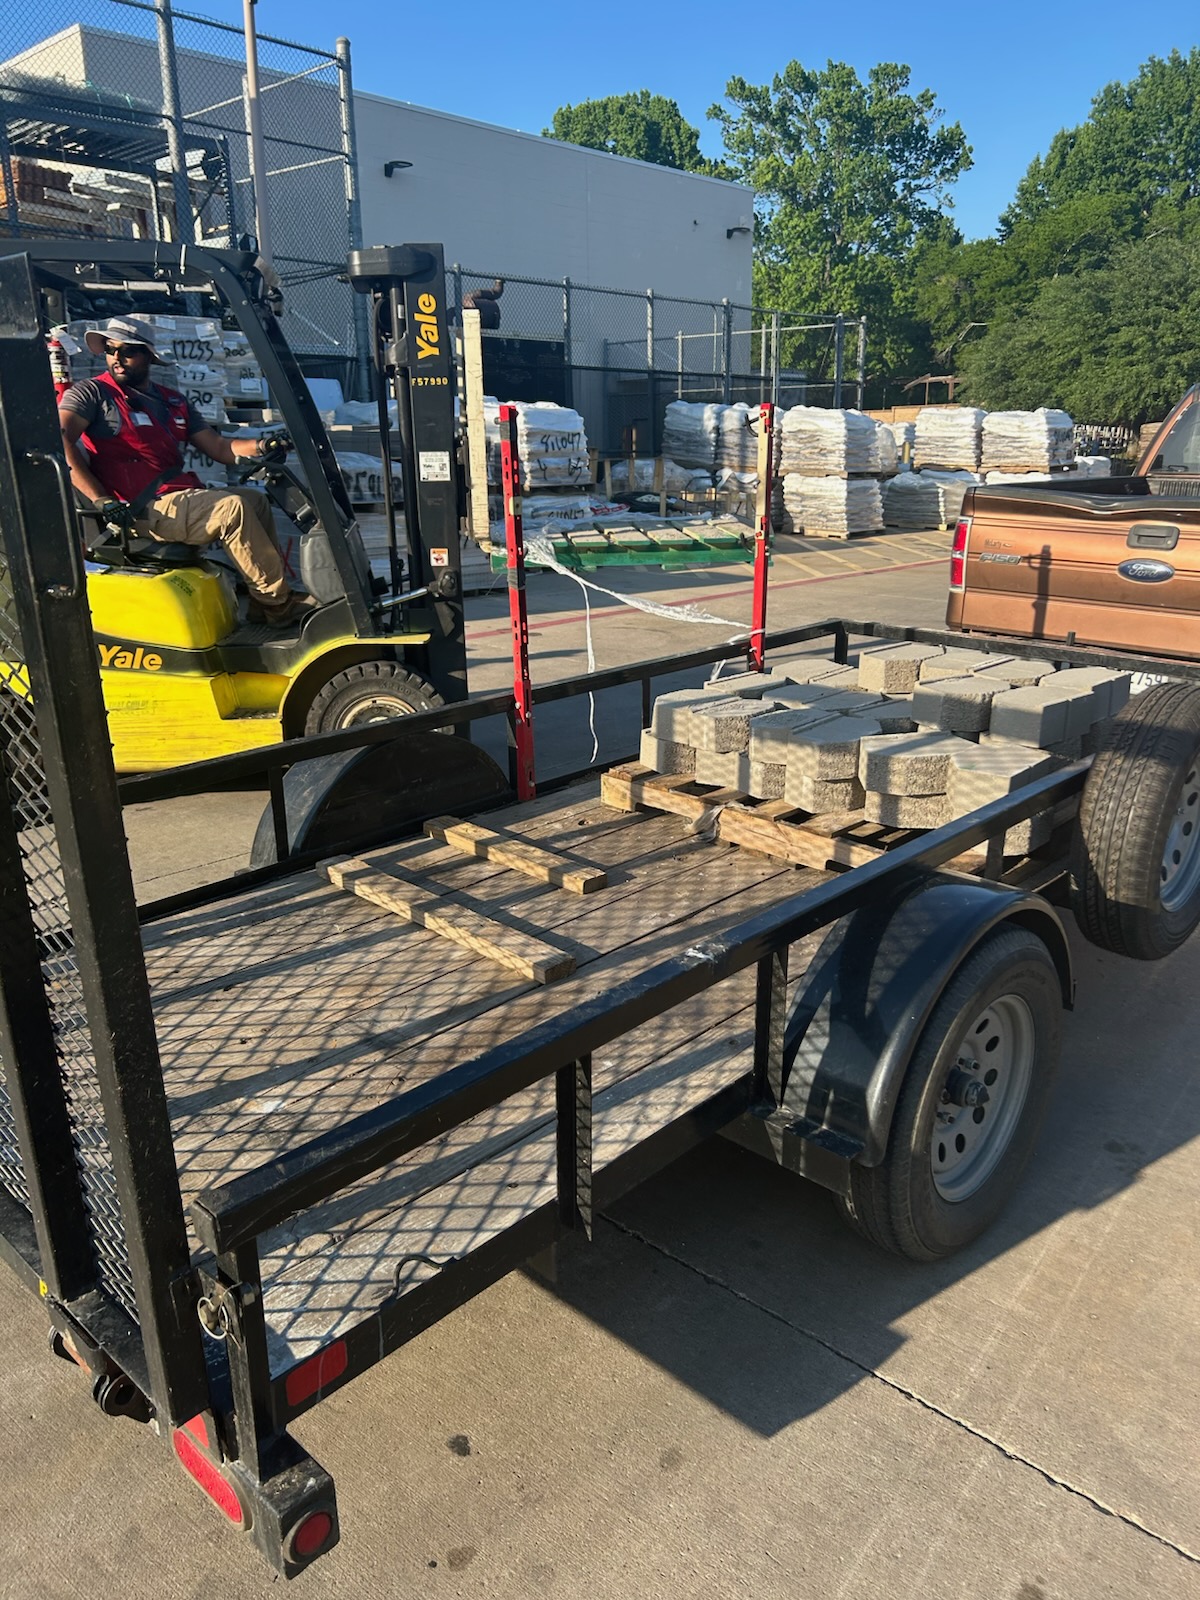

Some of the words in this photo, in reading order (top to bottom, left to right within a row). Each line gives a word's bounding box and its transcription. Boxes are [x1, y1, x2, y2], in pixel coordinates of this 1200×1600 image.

[413, 293, 440, 360] Yale
[1128, 563, 1160, 577] Ford
[98, 644, 163, 671] Yale
[1130, 671, 1163, 686] 759
